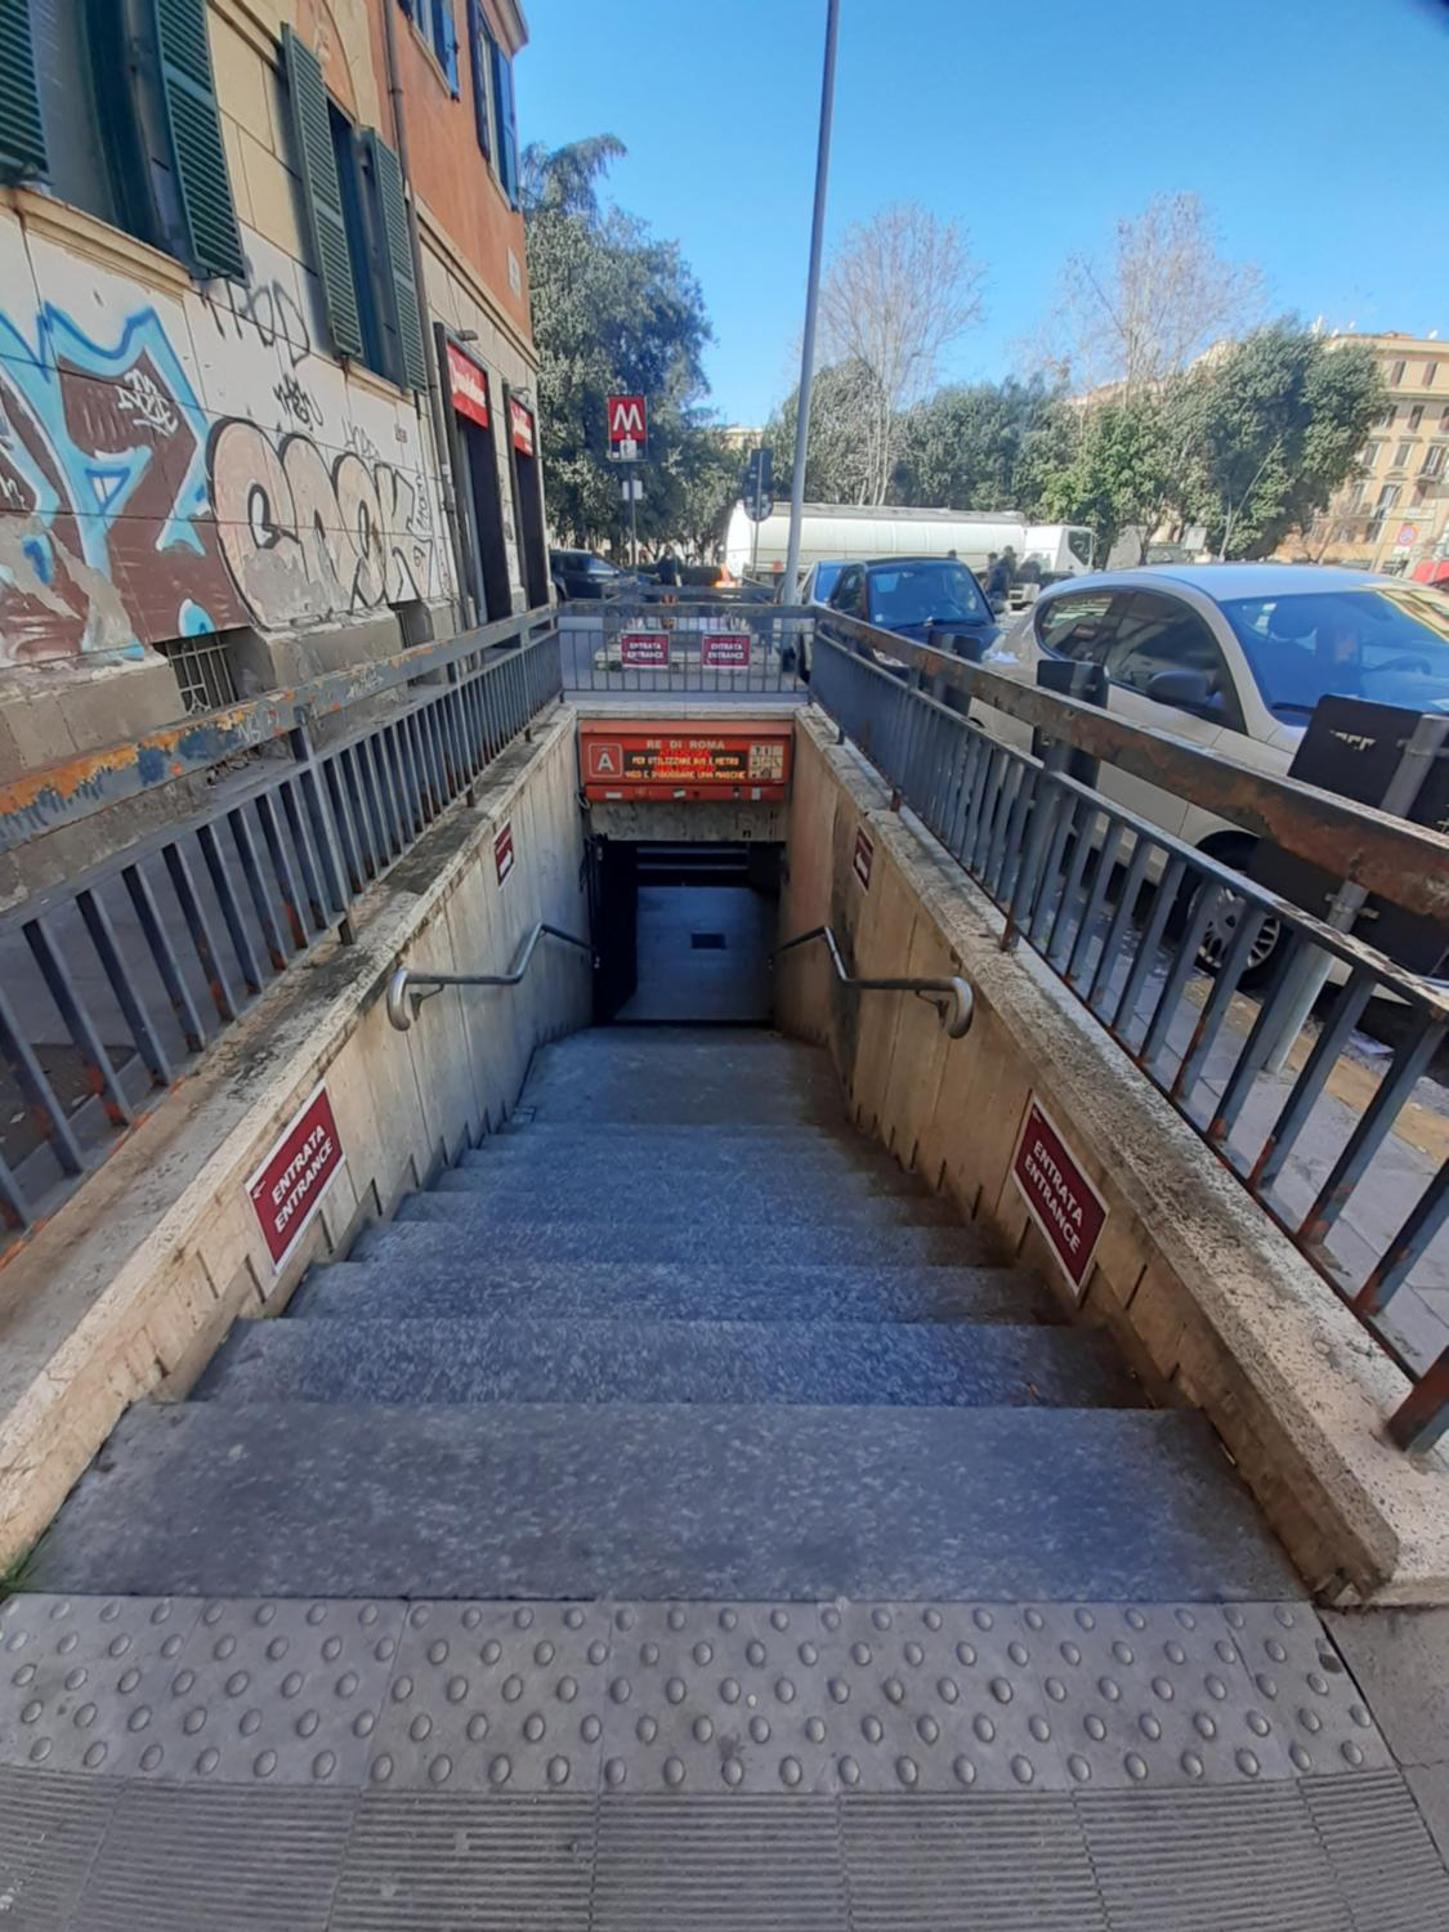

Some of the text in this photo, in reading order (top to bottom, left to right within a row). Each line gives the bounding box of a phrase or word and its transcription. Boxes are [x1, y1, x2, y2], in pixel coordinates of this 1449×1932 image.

[612, 403, 643, 432] M
[627, 651, 664, 659] ENTRANCE
[629, 642, 661, 650] ENTRATA
[708, 651, 744, 660] ENTRANCE
[711, 643, 743, 651] ENTRATA
[646, 740, 725, 749] RE DI ROMA
[598, 752, 614, 771] A
[271, 1124, 326, 1206] ENTRATA
[273, 1136, 334, 1234] ENTRANCE
[1033, 1140, 1084, 1228] ENTRATA
[1023, 1155, 1081, 1254] ENTRANCE
